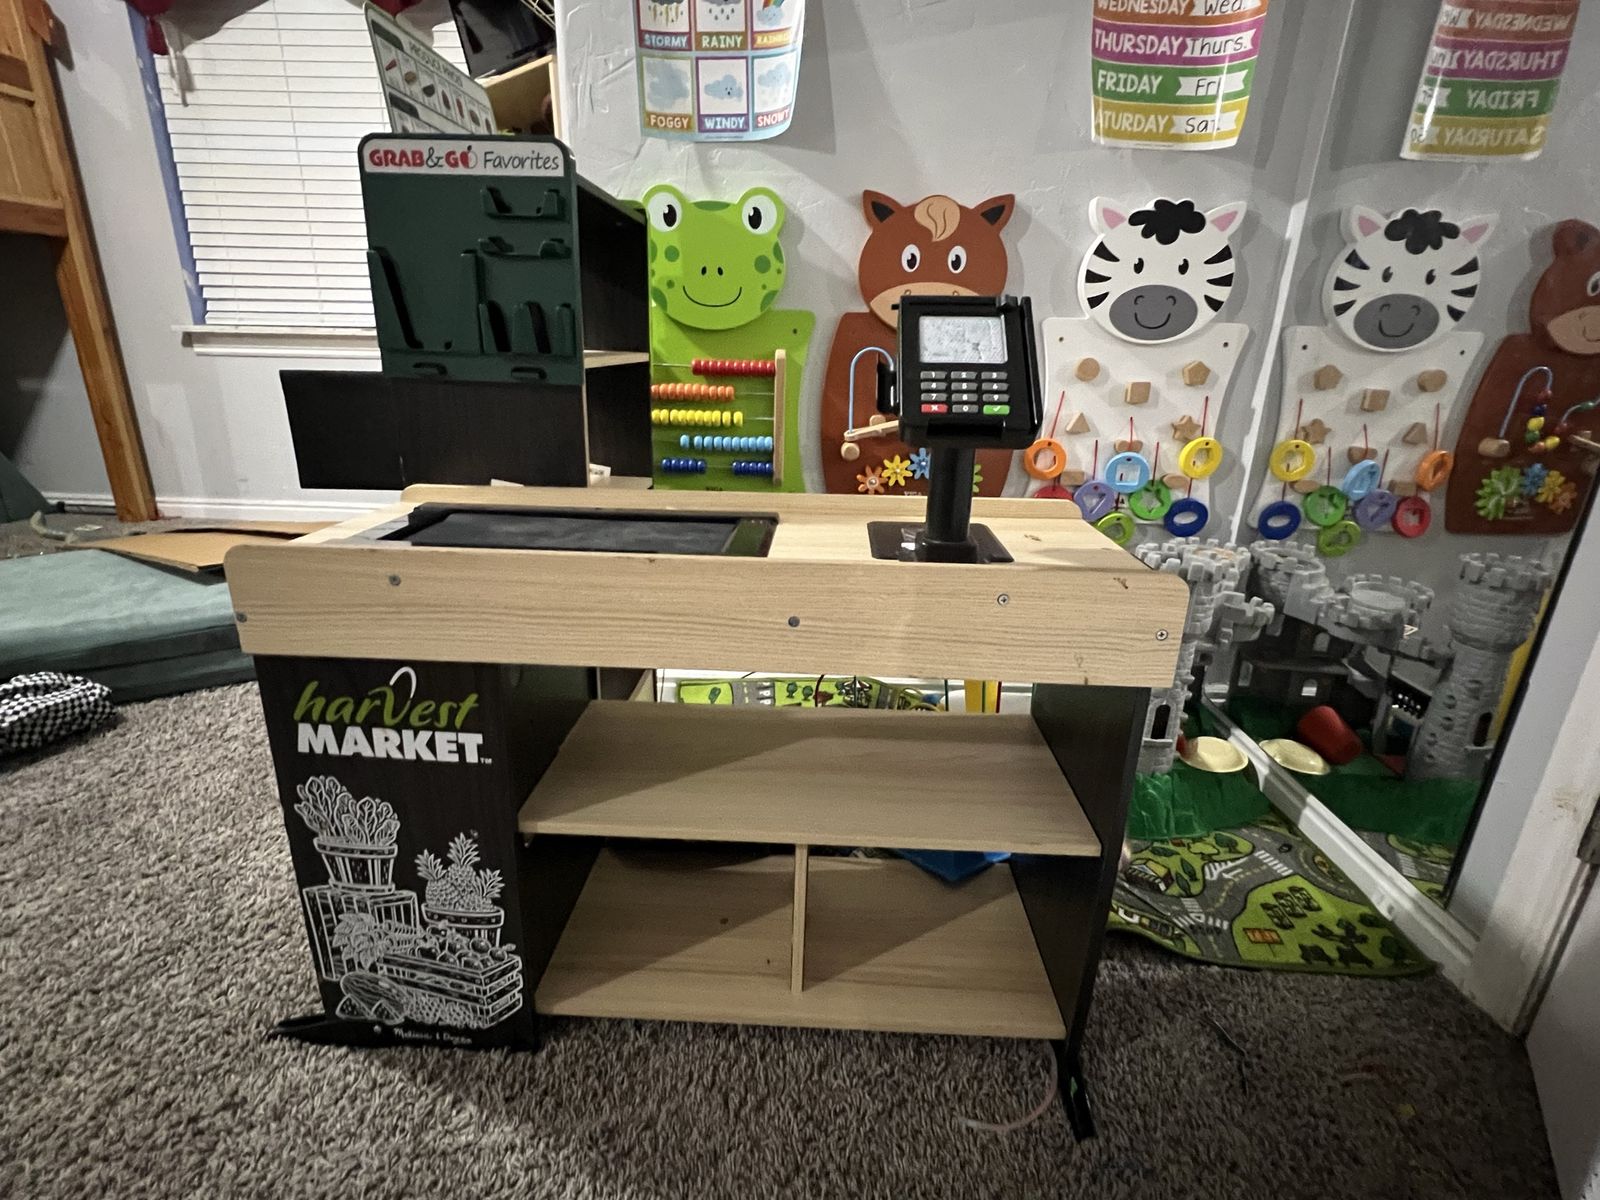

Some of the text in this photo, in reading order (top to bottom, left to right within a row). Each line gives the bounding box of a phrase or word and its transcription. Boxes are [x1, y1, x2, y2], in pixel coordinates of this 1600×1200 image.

[643, 35, 689, 48] STORMY
[701, 35, 744, 49] RAINY
[1094, 28, 1184, 56] THURSDAY
[1097, 69, 1163, 94] FRIDAY
[650, 114, 690, 129] FOGGY
[704, 116, 746, 130] WINDY
[757, 108, 791, 128] SNOWY
[1094, 109, 1169, 134] ATURDAY
[484, 150, 560, 170] Favorites
[293, 667, 479, 729] harvest
[297, 722, 484, 764] MARKET
